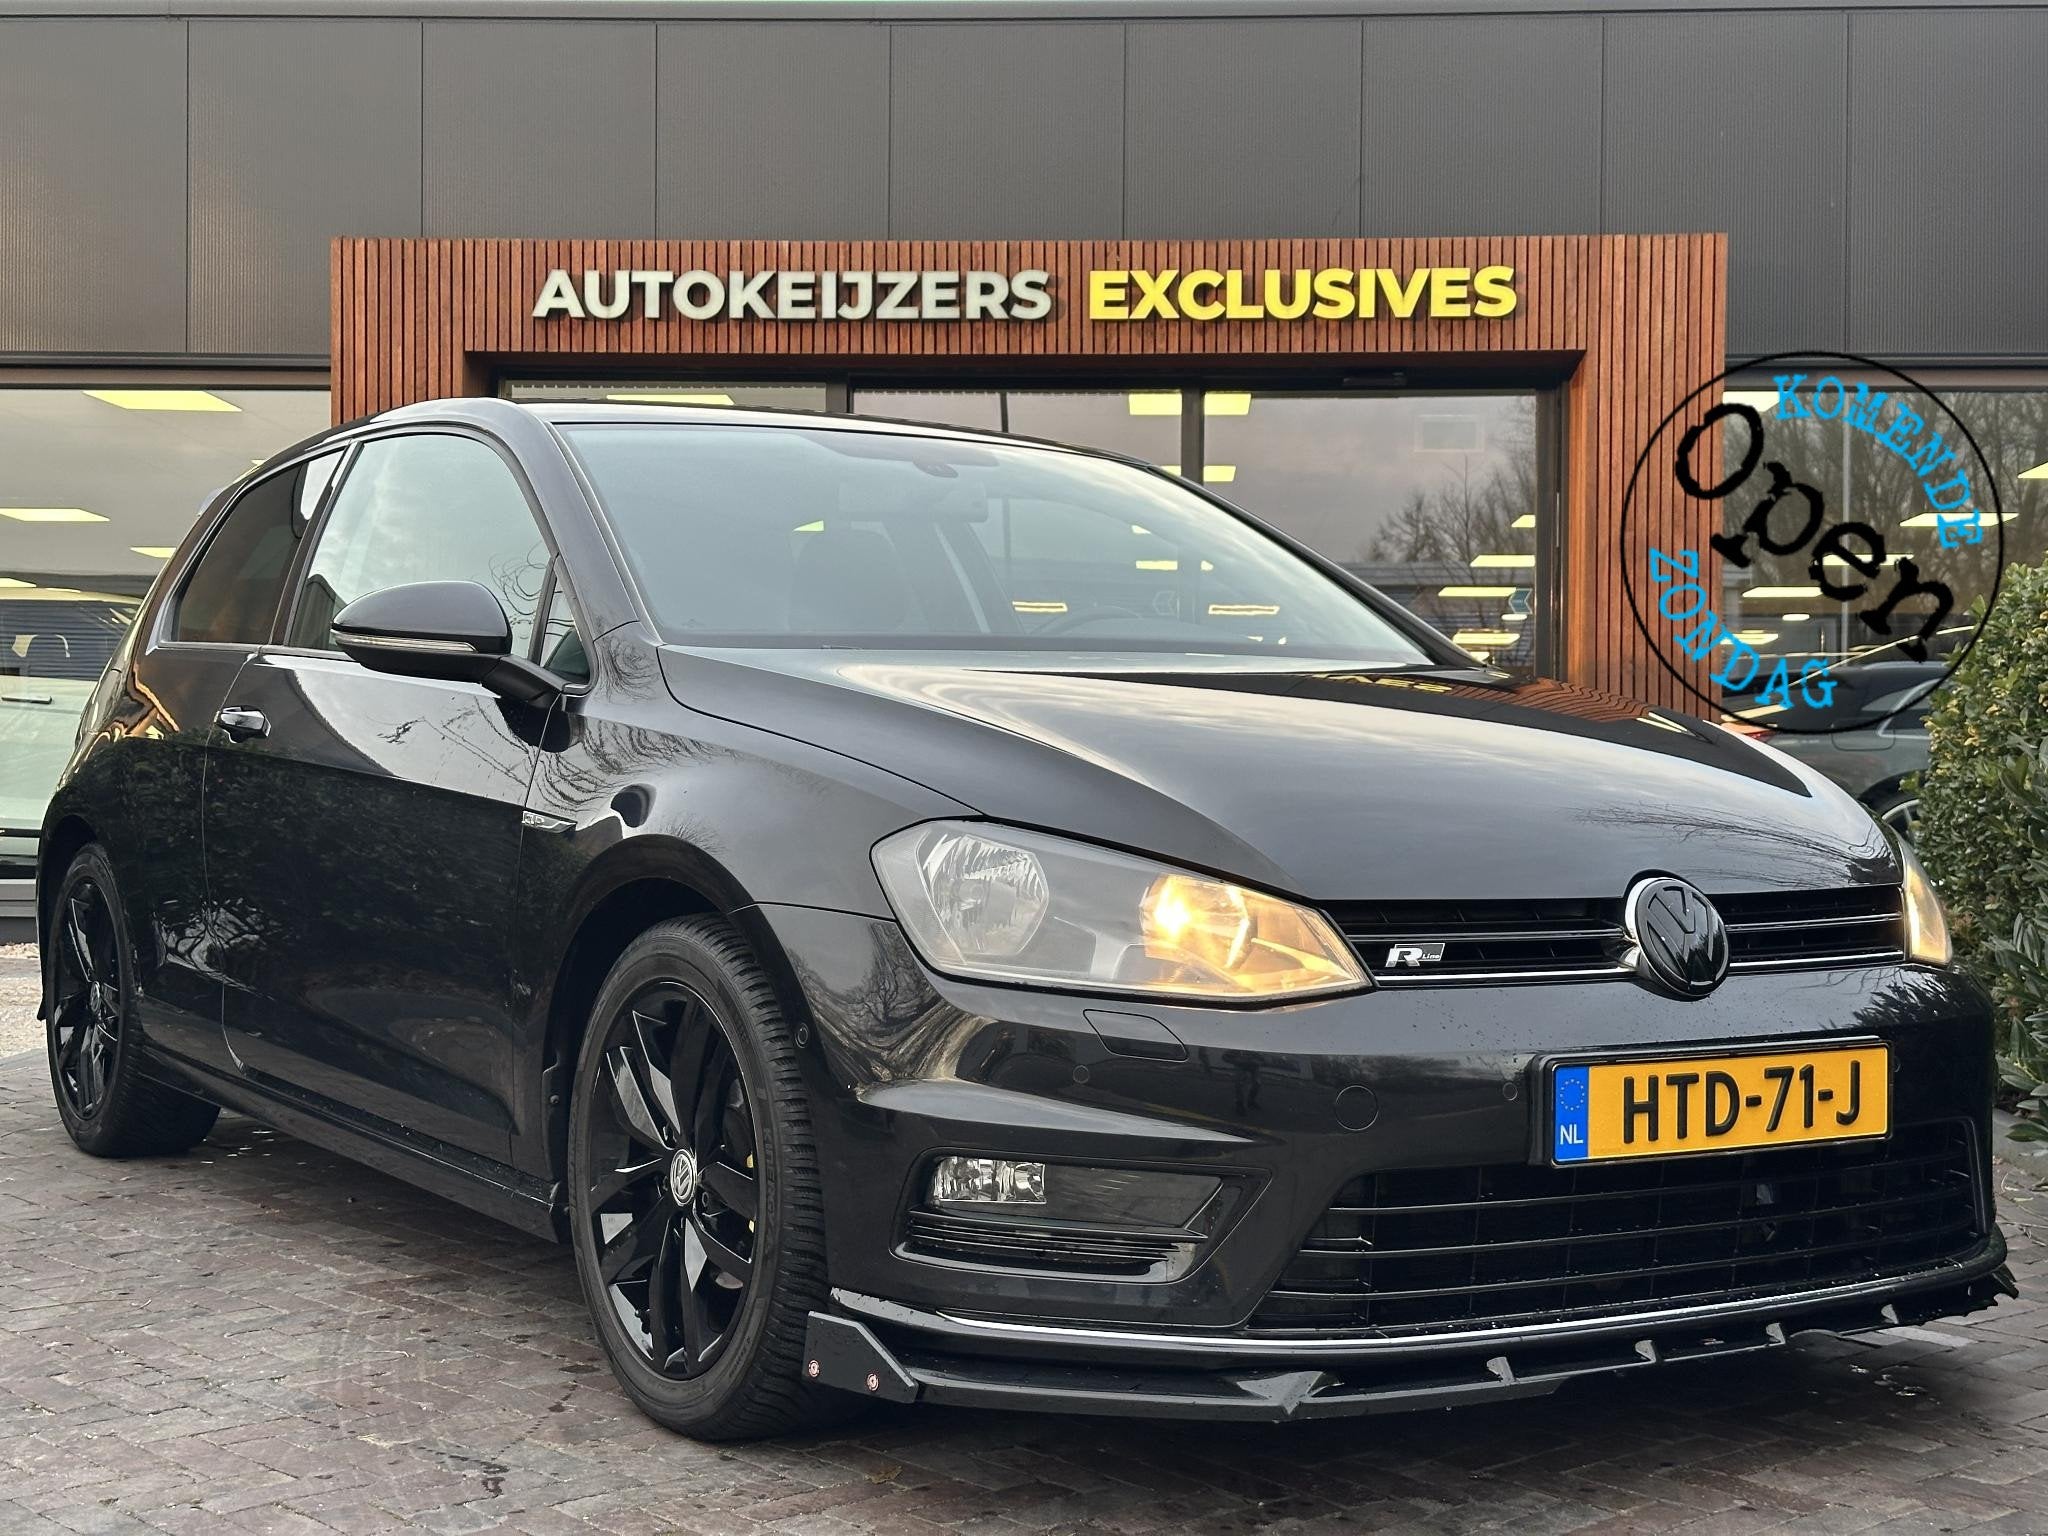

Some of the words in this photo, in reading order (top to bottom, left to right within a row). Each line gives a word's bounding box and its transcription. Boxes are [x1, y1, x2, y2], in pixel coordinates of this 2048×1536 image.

[532, 269, 1053, 320] AUTOKEIJZERS
[1089, 266, 1518, 319] EXCLUSIVES
[1623, 1060, 1861, 1144] HTD-71-J
[1559, 1124, 1584, 1145] NL
